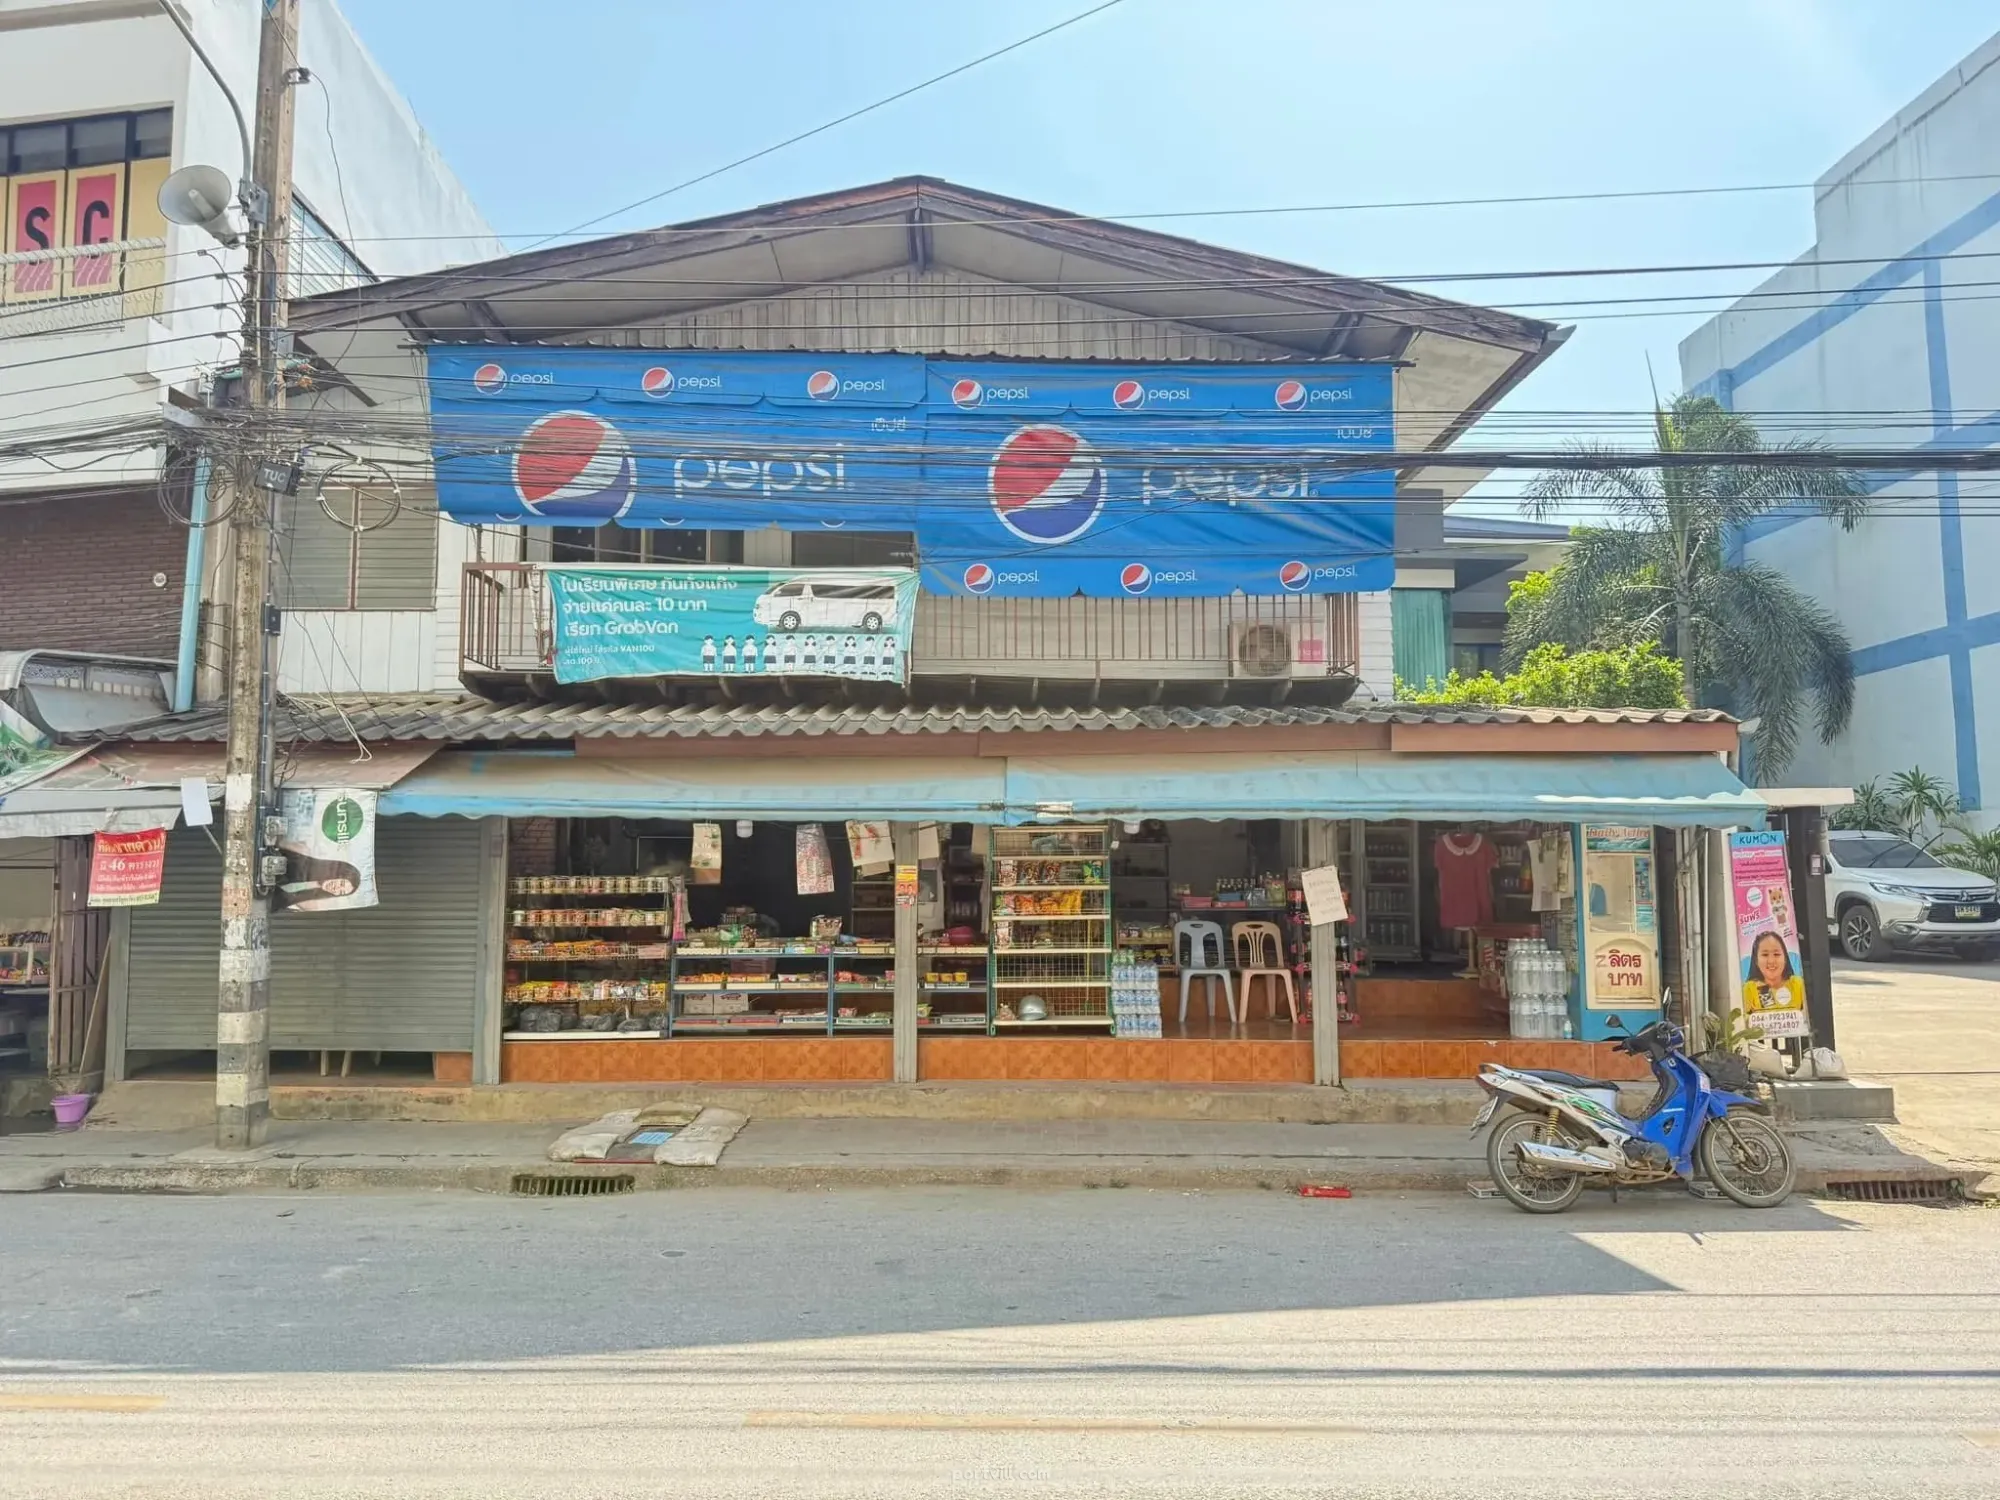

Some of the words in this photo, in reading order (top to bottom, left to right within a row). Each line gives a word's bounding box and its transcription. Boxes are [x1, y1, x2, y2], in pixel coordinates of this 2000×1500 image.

[25, 206, 51, 266] S
[509, 371, 554, 386] pepsi
[677, 375, 722, 391] pepsi
[842, 378, 885, 393] pepsi
[986, 387, 1029, 401] pepsi
[1148, 387, 1191, 401] pepsi
[1310, 388, 1352, 402] pepsi
[263, 467, 286, 483] TUC
[673, 443, 847, 498] pepsi
[998, 570, 1039, 585] pepsi
[1154, 570, 1197, 585] pepsi
[1314, 566, 1358, 581] pepsi
[562, 598, 652, 614] จ่ายแค่คนละ
[656, 597, 674, 612] 10
[679, 597, 708, 612] บาท
[564, 620, 602, 637] เรียก
[604, 620, 679, 635] GrabVan
[620, 644, 655, 653] VAN100
[1739, 833, 1777, 845] KUMON
[108, 857, 126, 871] 46
[1608, 948, 1642, 968] ลิตร
[1607, 972, 1643, 986] บาท
